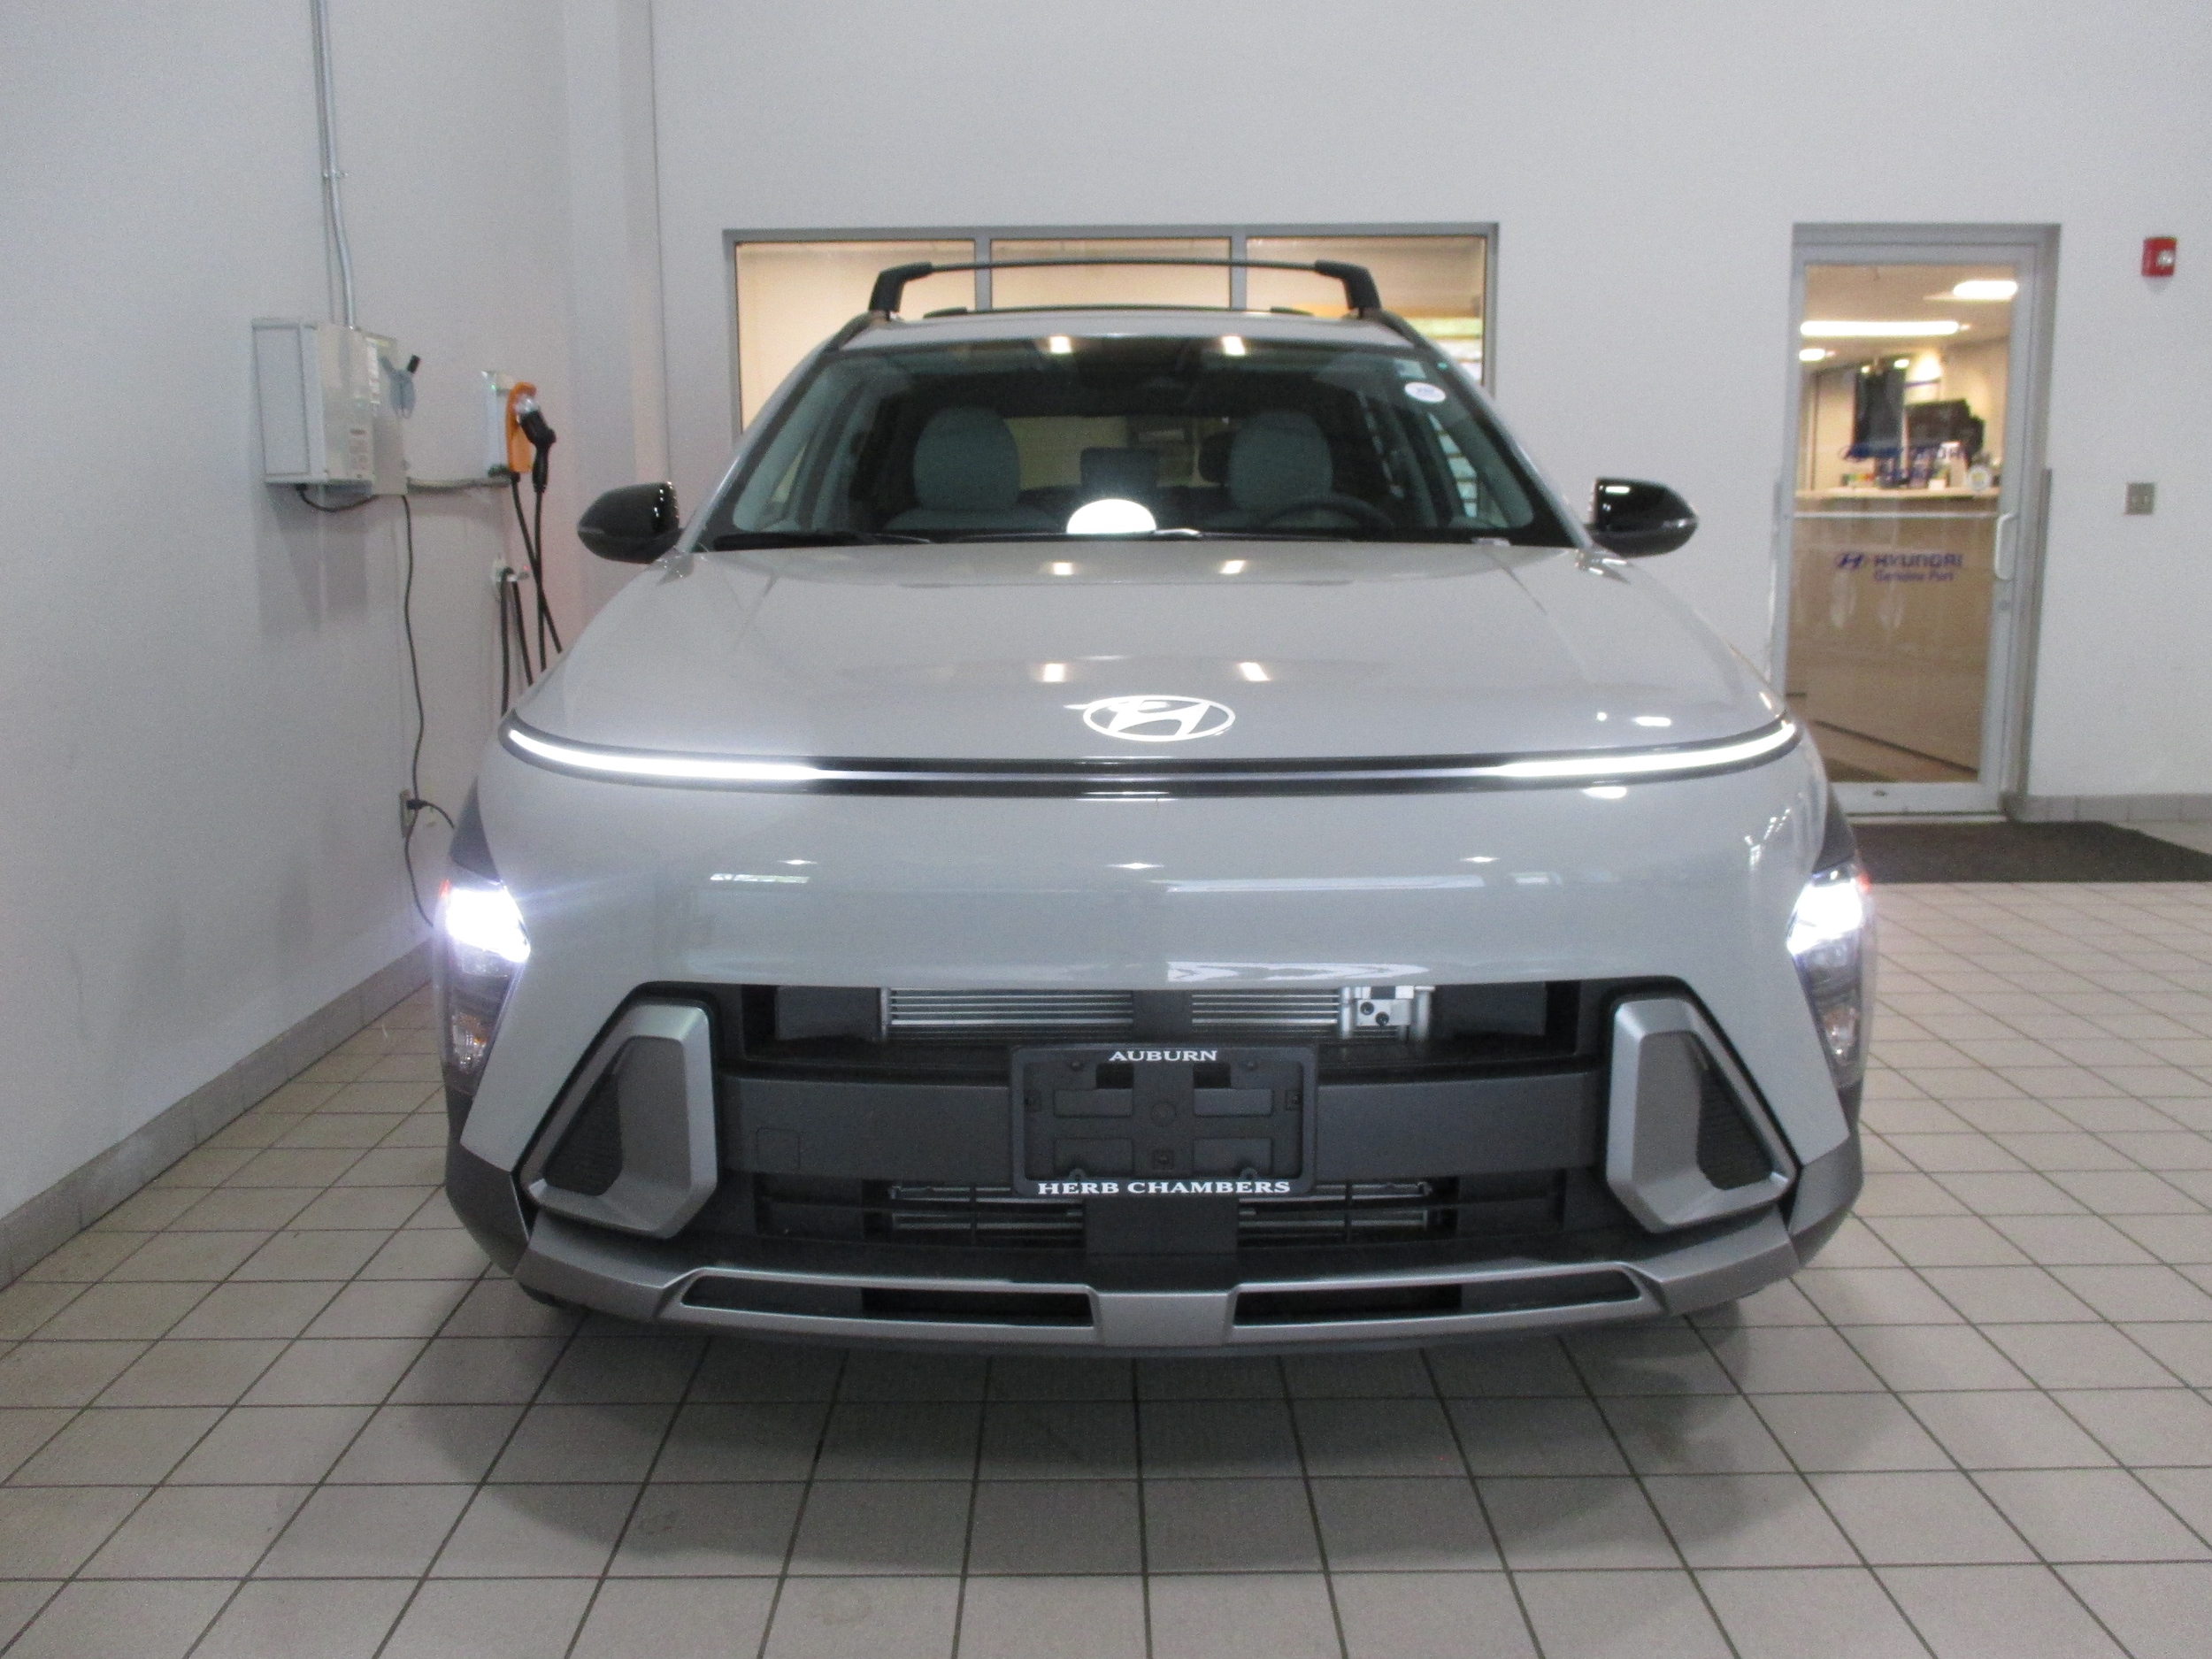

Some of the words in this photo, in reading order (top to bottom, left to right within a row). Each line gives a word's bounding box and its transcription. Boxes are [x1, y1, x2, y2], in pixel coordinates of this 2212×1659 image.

[1874, 554, 1962, 567] HYUNDAI
[1109, 1050, 1218, 1062] AUBURN
[1038, 1182, 1119, 1194] HERB
[1127, 1181, 1291, 1194] CHAMBERS
